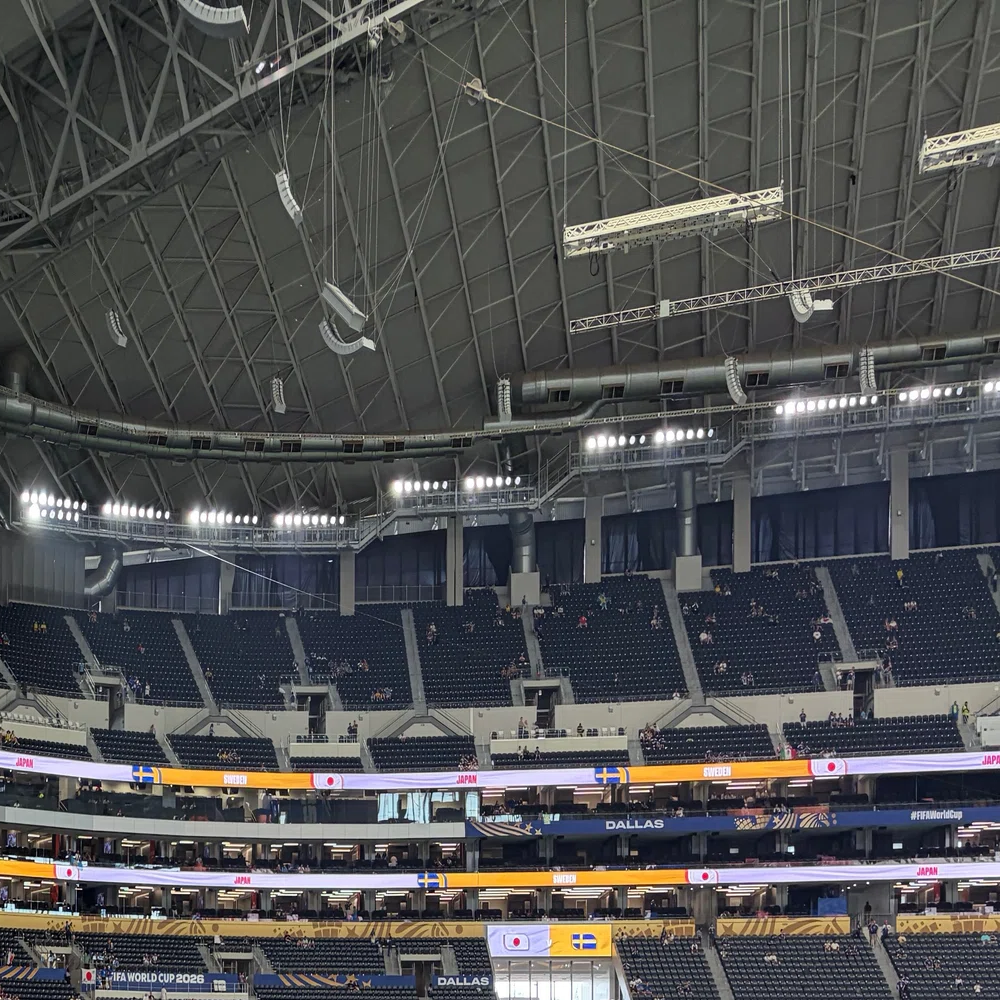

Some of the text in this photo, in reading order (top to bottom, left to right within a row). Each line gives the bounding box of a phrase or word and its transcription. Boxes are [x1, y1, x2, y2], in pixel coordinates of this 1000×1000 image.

[15, 757, 34, 769] JAPAN
[982, 754, 1000, 766] JAPA
[703, 766, 731, 778] SWEDEN
[223, 774, 247, 786] SWEDEN
[456, 774, 478, 785] JAPAN
[910, 809, 963, 820] #FIFAWorldCup
[605, 820, 664, 830] DALLAS
[916, 866, 939, 877] JAPAN
[233, 876, 251, 886] JAPAN
[553, 874, 577, 885] SWEDEN
[127, 973, 158, 983] WORLD
[158, 973, 175, 983] CUP
[176, 974, 204, 984] 2026
[437, 977, 489, 987] DALLAS
